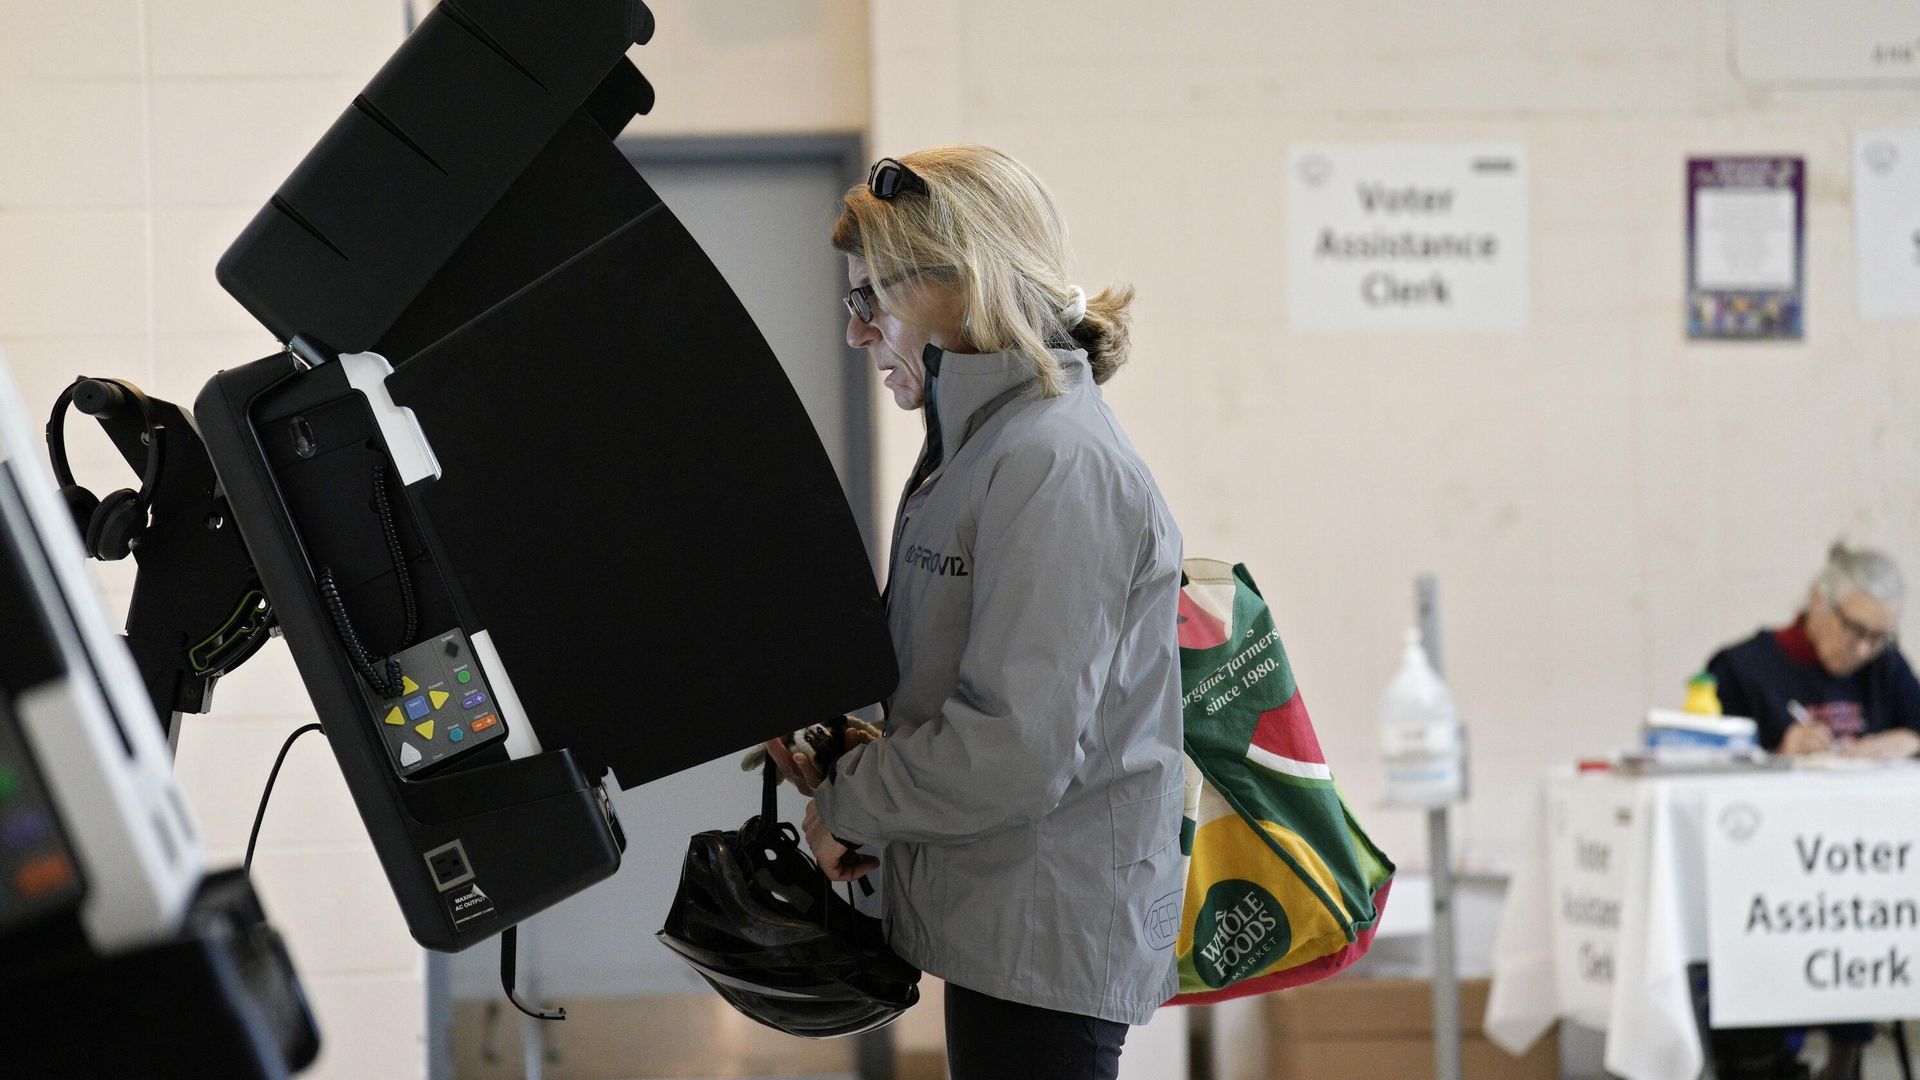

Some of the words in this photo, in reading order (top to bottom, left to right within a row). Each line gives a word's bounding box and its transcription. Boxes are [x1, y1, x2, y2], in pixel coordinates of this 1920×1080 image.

[1356, 181, 1455, 215] Voter
[1315, 227, 1498, 263] Assistance
[1361, 270, 1452, 308] Clerk
[1205, 684, 1241, 716] since
[1241, 657, 1280, 689] 1980.
[1793, 833, 1912, 876] Voter
[1200, 891, 1265, 962] WHOLE
[1745, 891, 1920, 936] Assistan
[1213, 909, 1277, 979] FOODS
[1231, 936, 1277, 980] MARKET
[1803, 944, 1912, 991] Clerk
